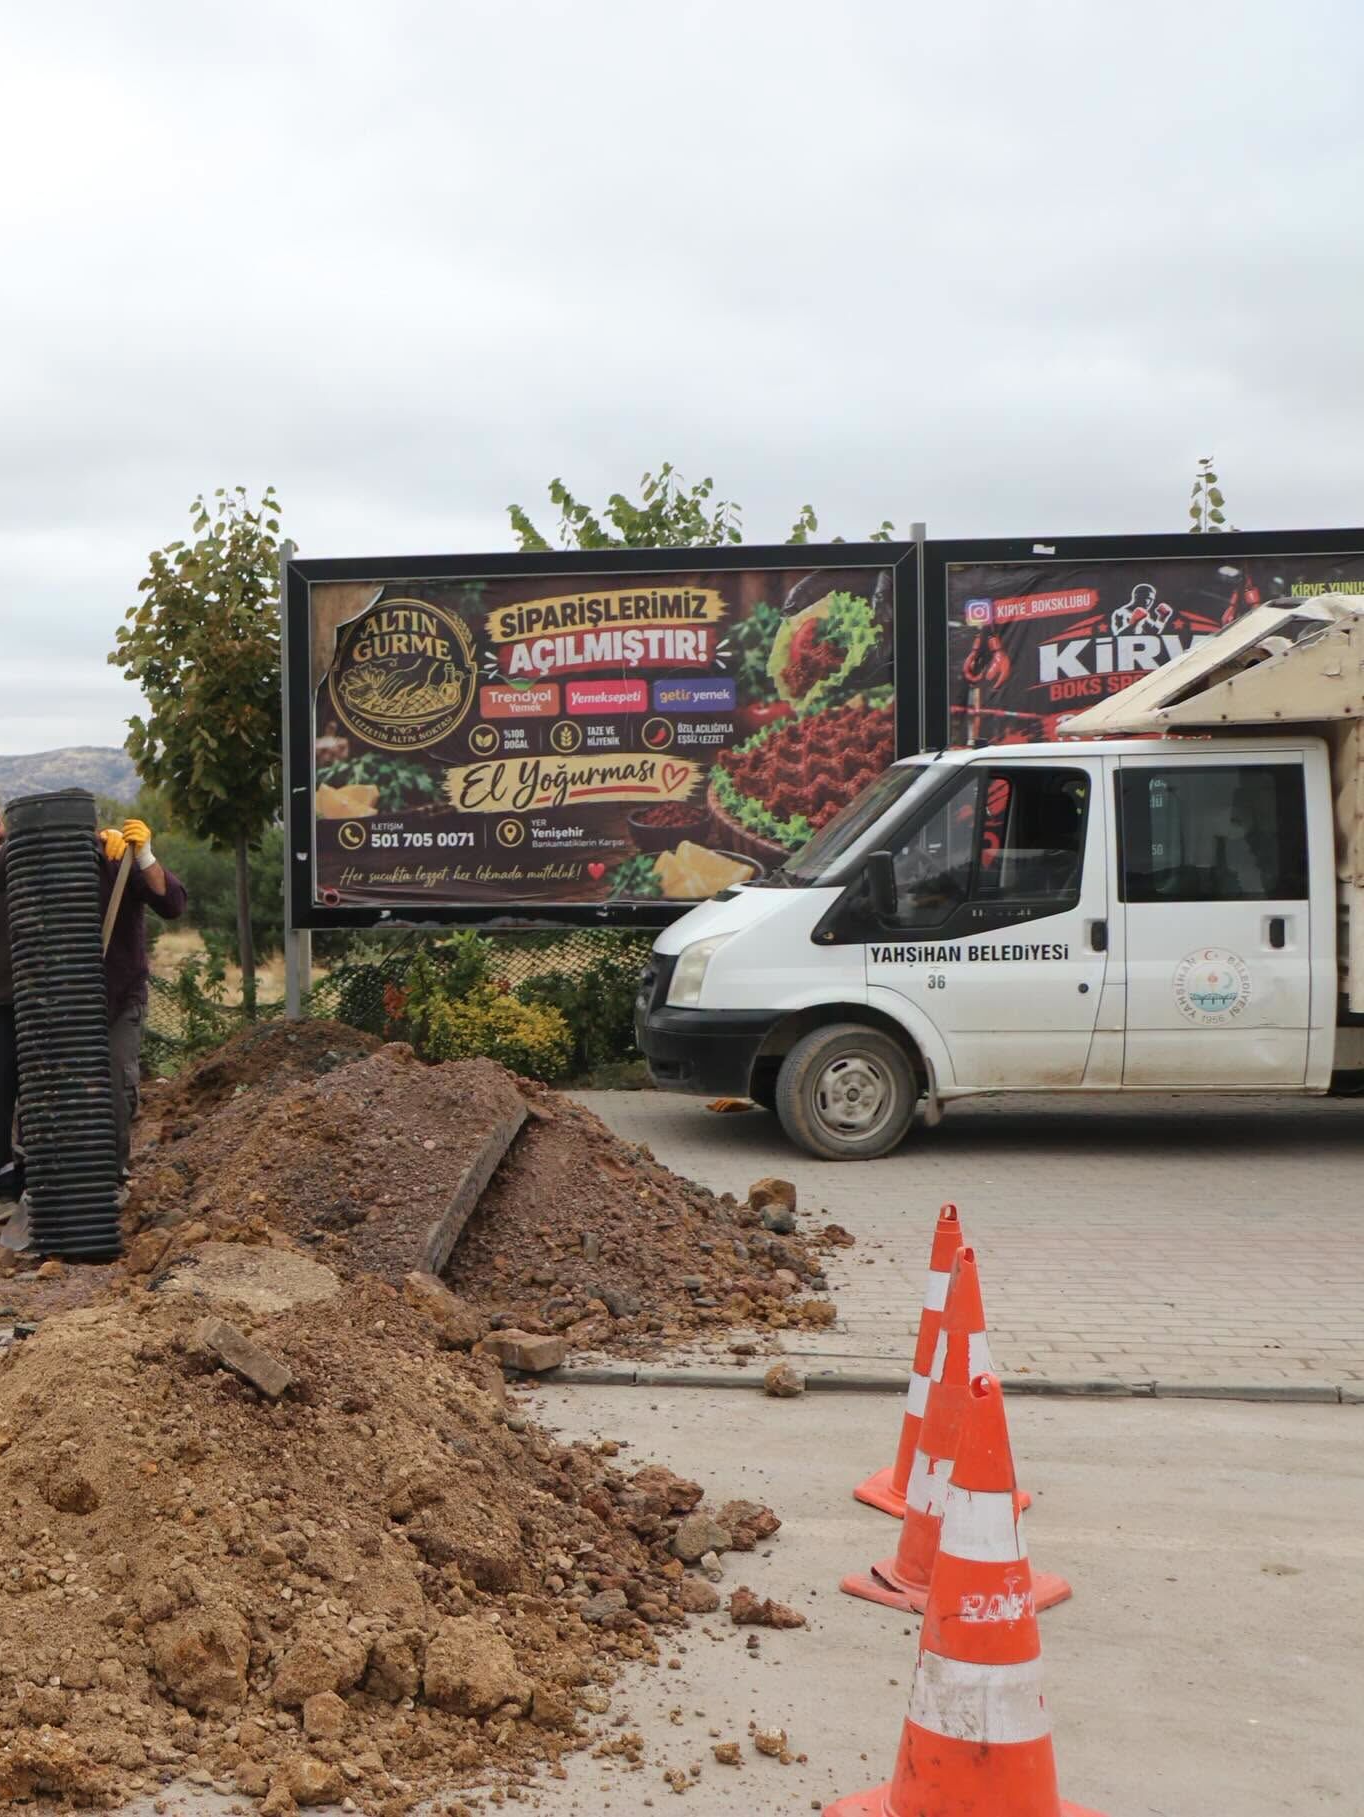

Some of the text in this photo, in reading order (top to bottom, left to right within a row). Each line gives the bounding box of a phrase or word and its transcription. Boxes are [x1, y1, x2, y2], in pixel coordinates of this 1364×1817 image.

[499, 590, 707, 638] SİPARİŞLERİMİZ
[360, 610, 438, 638] ALTIN
[352, 634, 452, 662] GURME
[508, 629, 707, 676] AÇILMIŞTIR!
[659, 688, 730, 704] getir yemek
[1050, 677, 1102, 701] BOKS
[489, 689, 552, 706] Trendyol
[571, 690, 641, 706] Yemeksepeti
[509, 703, 542, 713] Yemek
[605, 726, 615, 736] VE
[459, 759, 656, 809] El Yoğurması
[531, 818, 547, 827] YER
[371, 832, 475, 847] 501 705 0071
[531, 826, 584, 839] Yenişehir
[339, 866, 364, 887] Her
[453, 864, 473, 880] her
[475, 864, 524, 881] lokmada
[927, 974, 946, 990] 36
